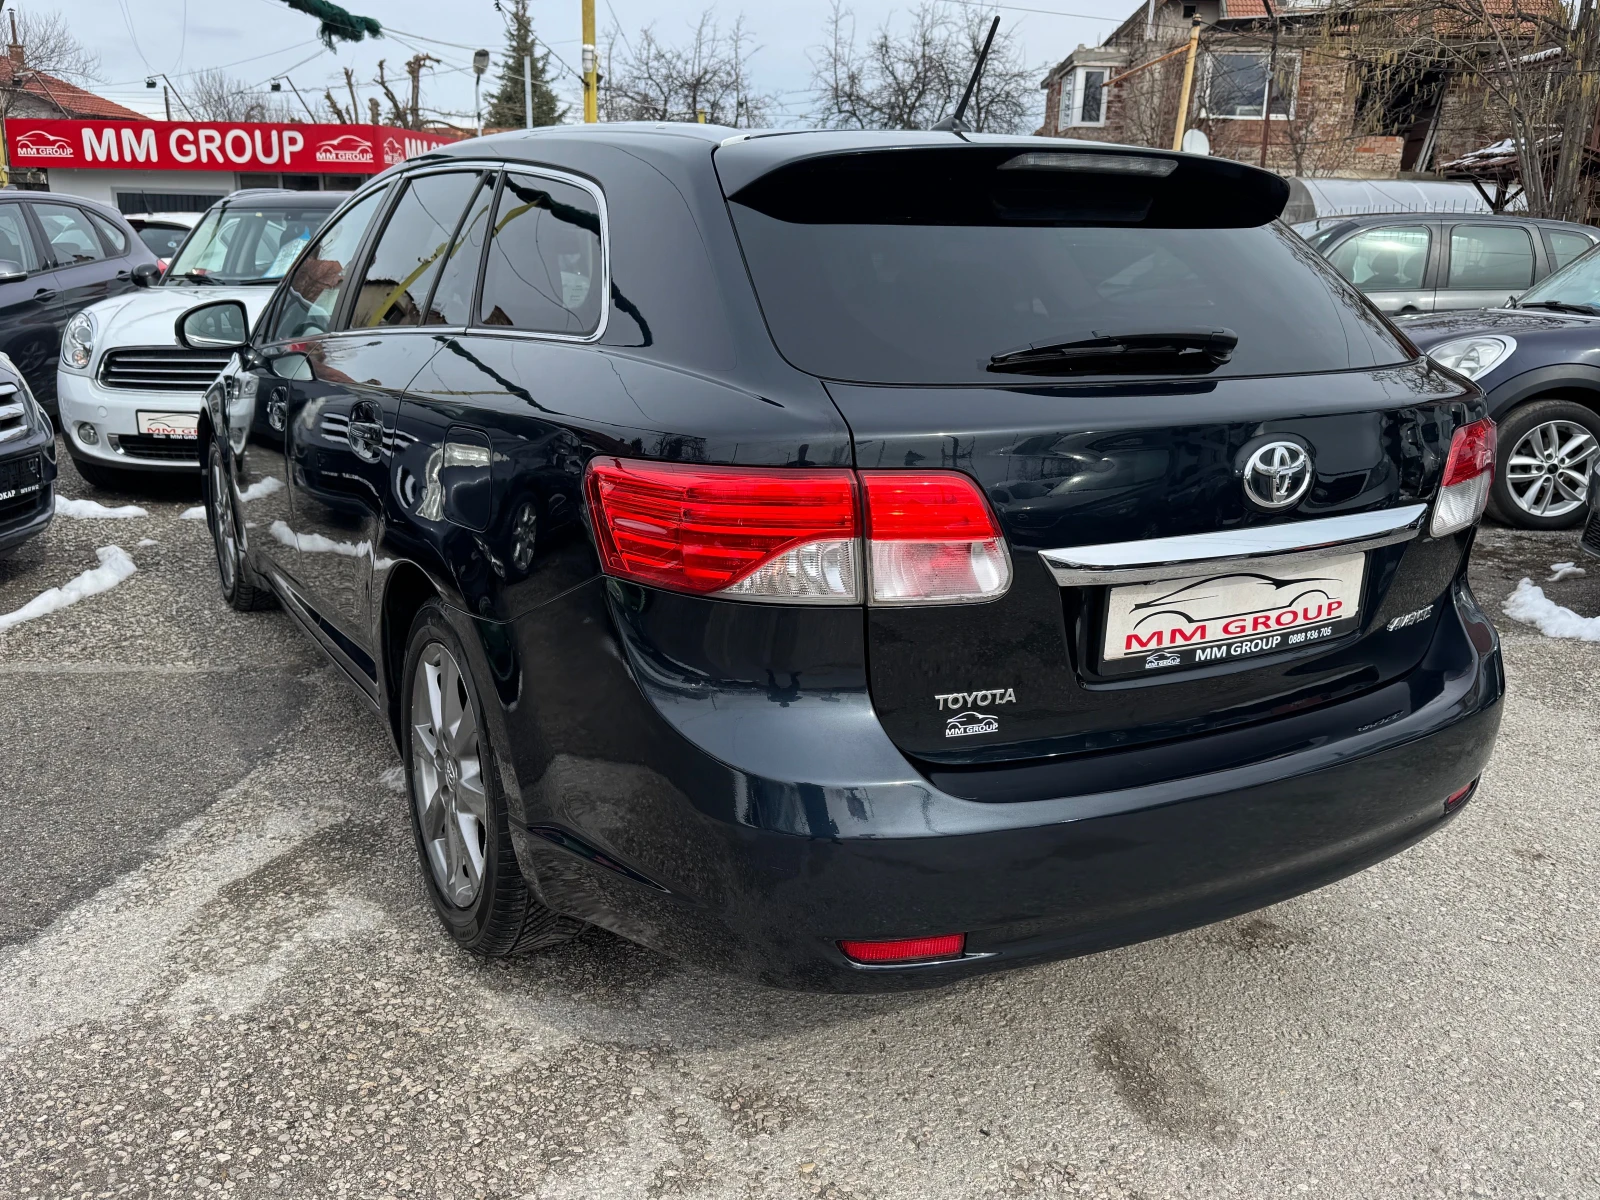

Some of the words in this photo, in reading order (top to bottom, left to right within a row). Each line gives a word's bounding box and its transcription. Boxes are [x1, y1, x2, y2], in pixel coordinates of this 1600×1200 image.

[17, 147, 37, 155] MM
[81, 127, 158, 162] MM
[169, 128, 304, 165] GROUP
[316, 152, 336, 160] MM
[338, 152, 373, 161] GROUP
[1124, 624, 1207, 651] MM
[1222, 600, 1343, 635] GROUP
[1195, 646, 1227, 662] MM
[1230, 636, 1281, 656] GROUP
[1288, 633, 1305, 645] 0888
[1306, 631, 1319, 641] 936
[1320, 626, 1332, 637] 705
[934, 688, 1017, 711] TOYOTA
[945, 728, 964, 736] MM
[966, 723, 999, 734] GROUP
